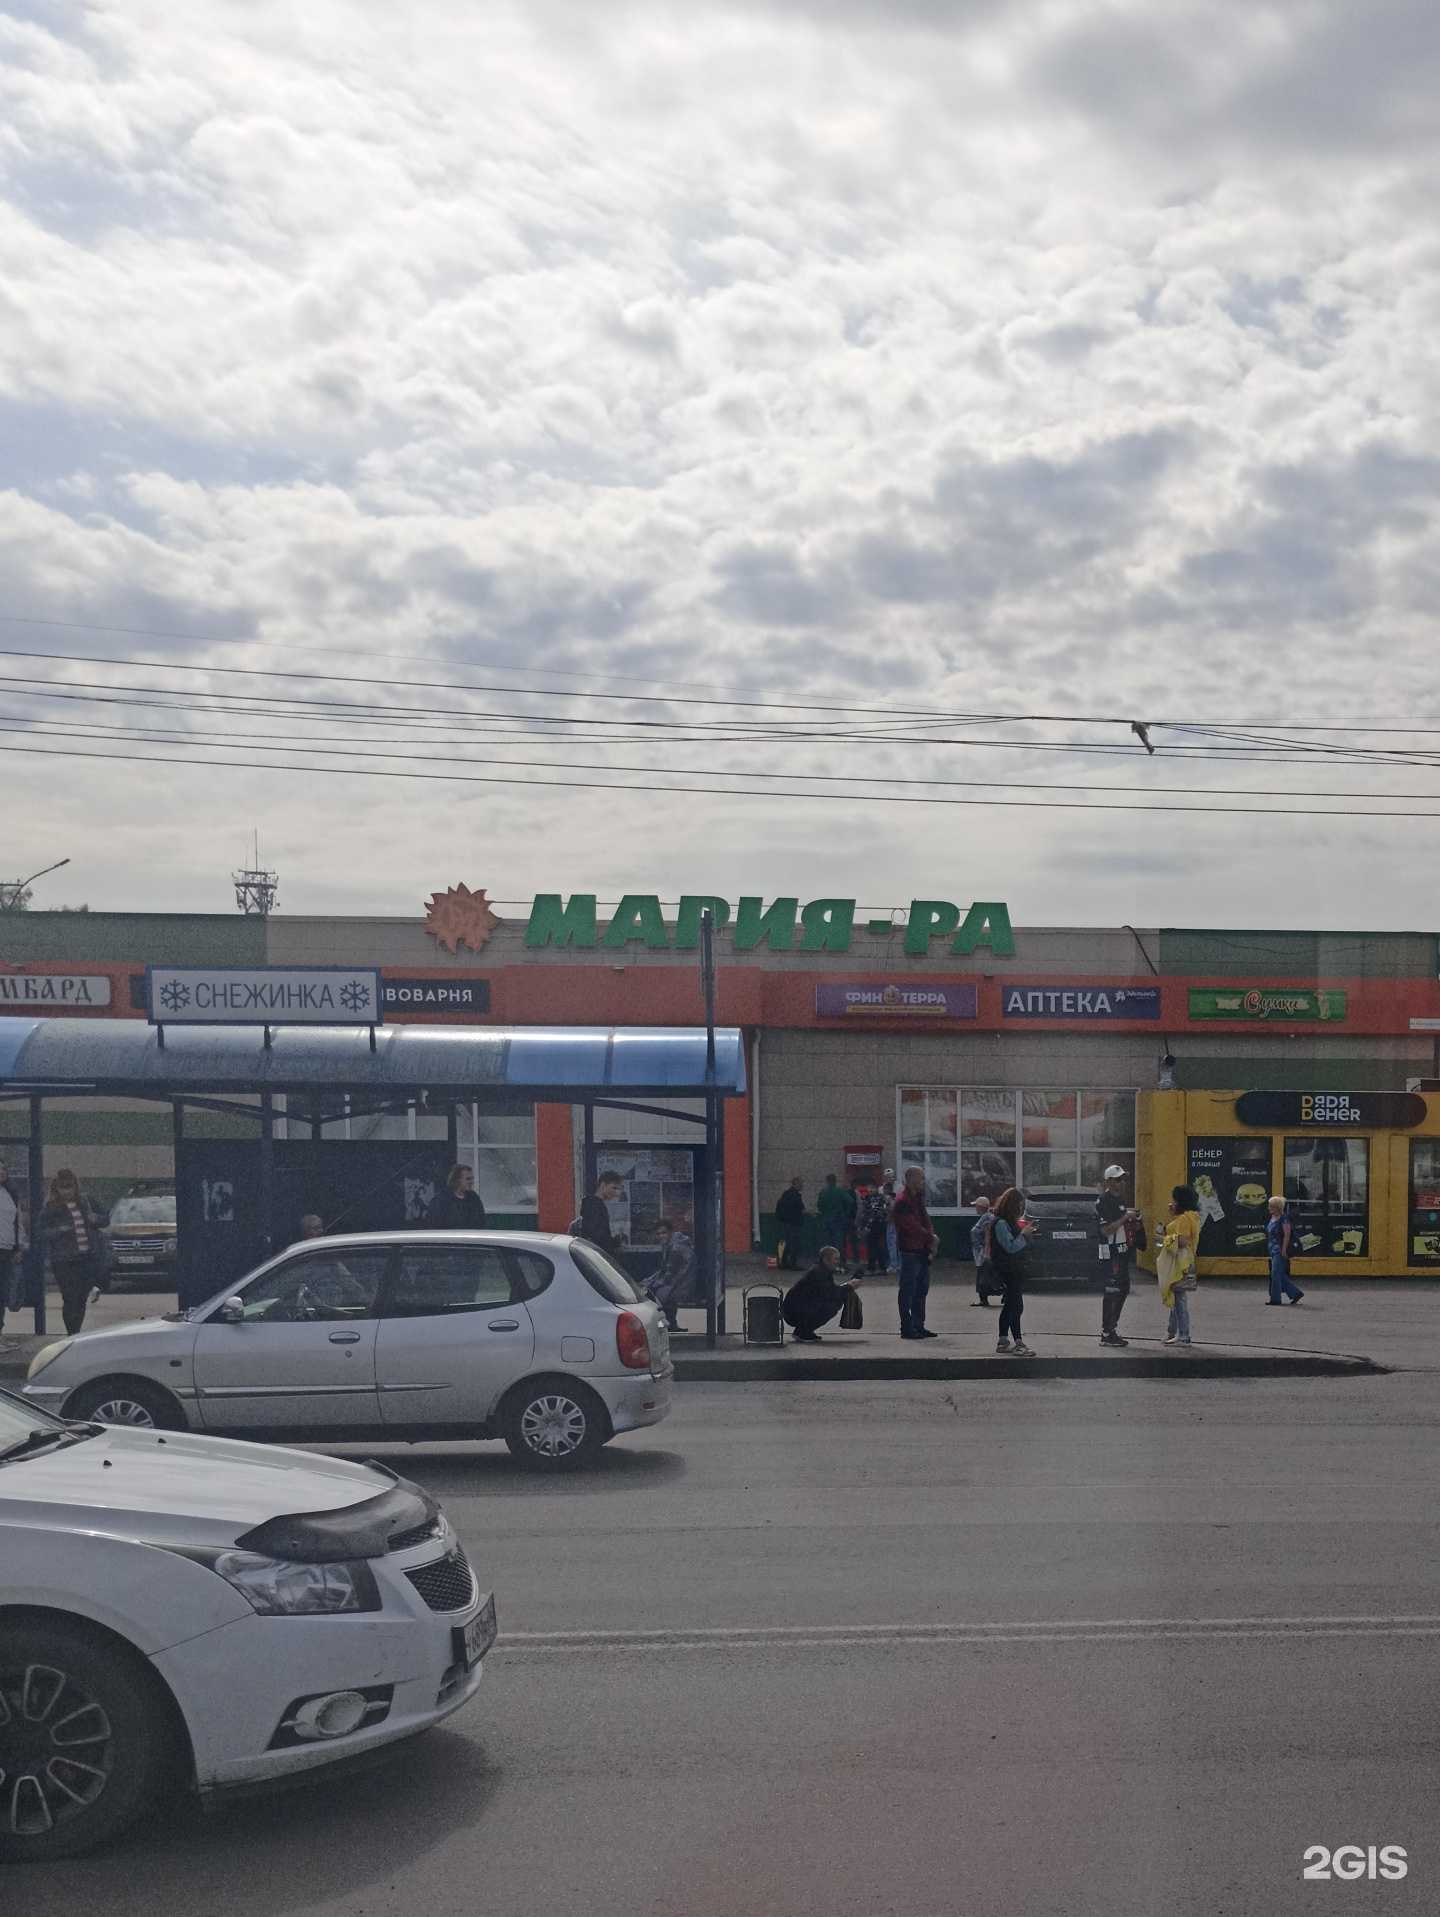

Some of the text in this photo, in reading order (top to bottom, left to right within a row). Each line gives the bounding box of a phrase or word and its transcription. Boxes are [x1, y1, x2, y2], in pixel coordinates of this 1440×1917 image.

[195, 982, 335, 1009] СНЕЖИНКА
[381, 988, 472, 1002] ВОВАРНЯ
[845, 991, 947, 1004] ФИН ТЕРРА
[1007, 991, 1112, 1013] АПТЕКА
